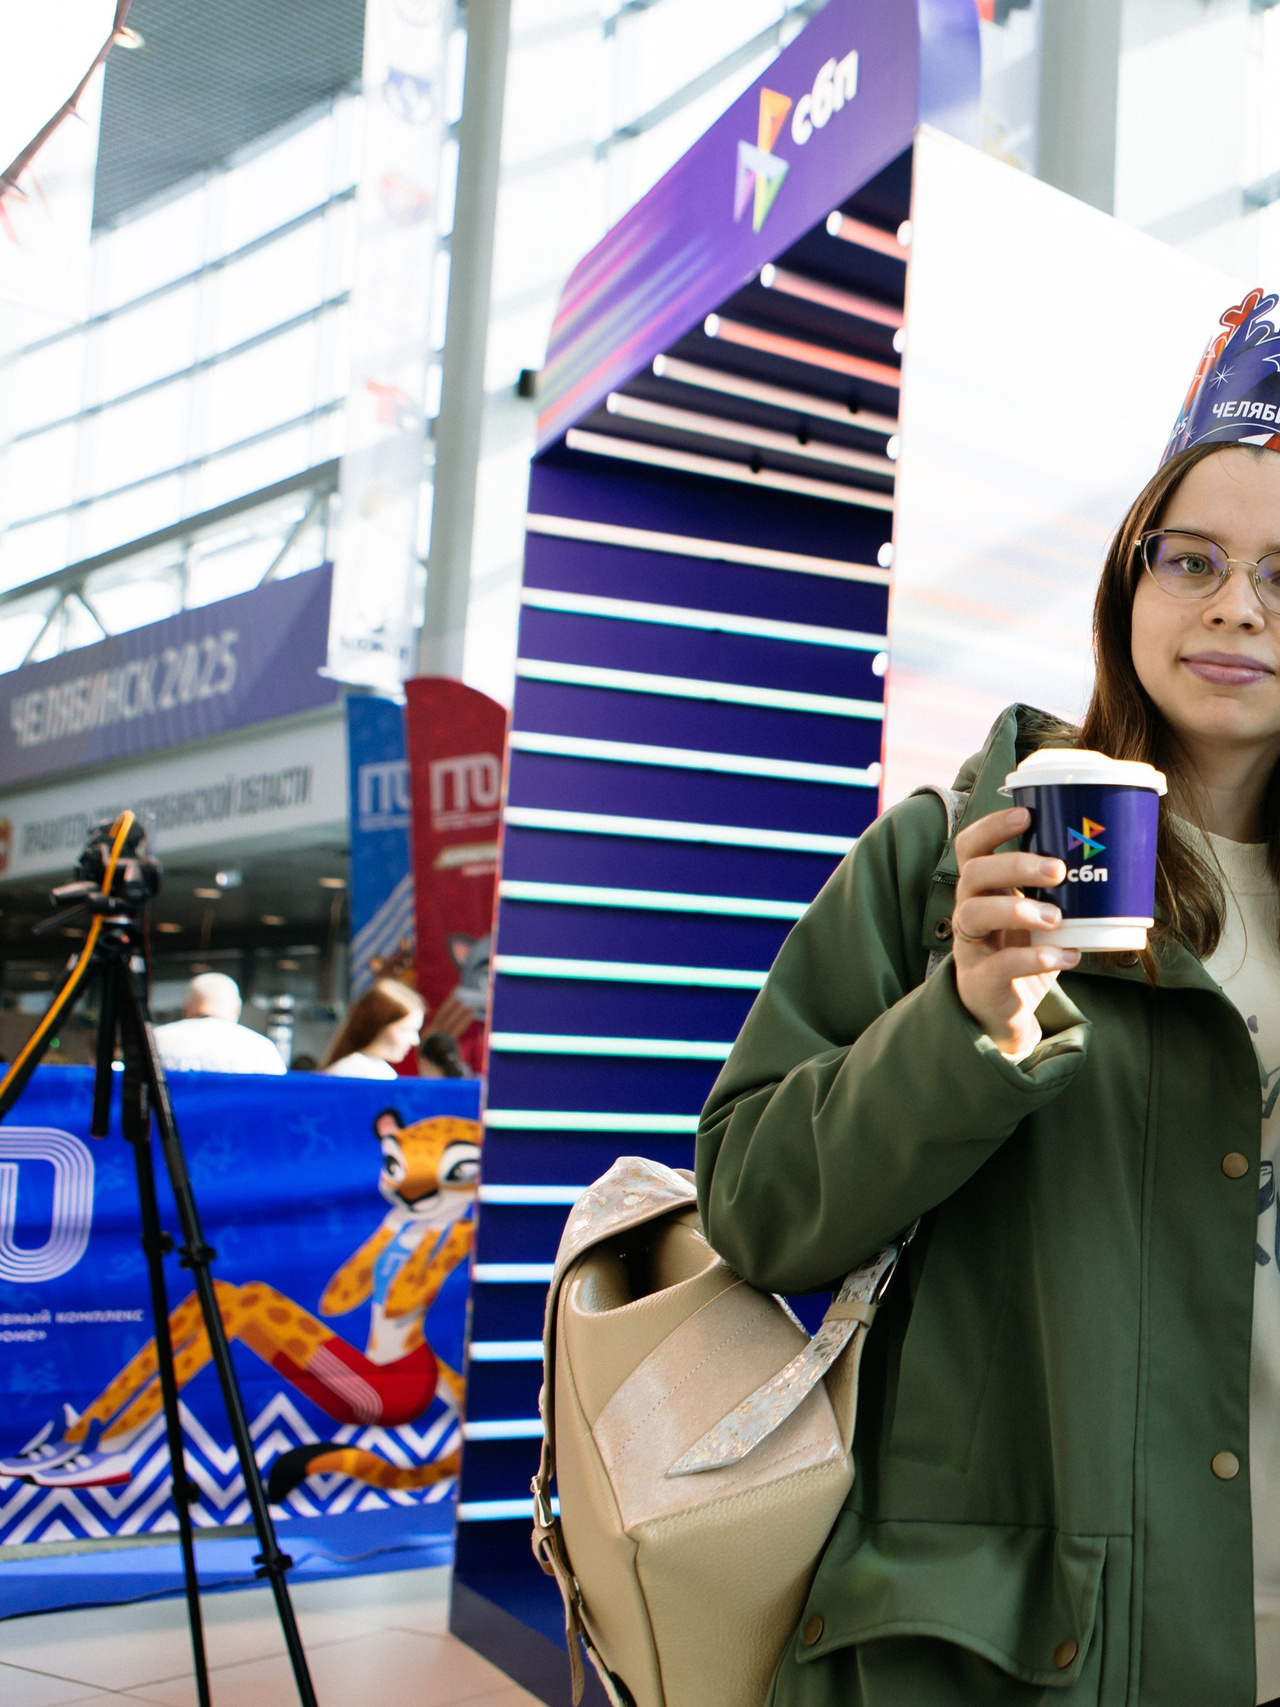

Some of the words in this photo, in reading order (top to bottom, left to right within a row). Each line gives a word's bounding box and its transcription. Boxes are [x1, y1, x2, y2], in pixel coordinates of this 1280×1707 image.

[791, 49, 858, 145] сбп
[158, 629, 240, 710] 2025
[1067, 865, 1108, 882] сбп
